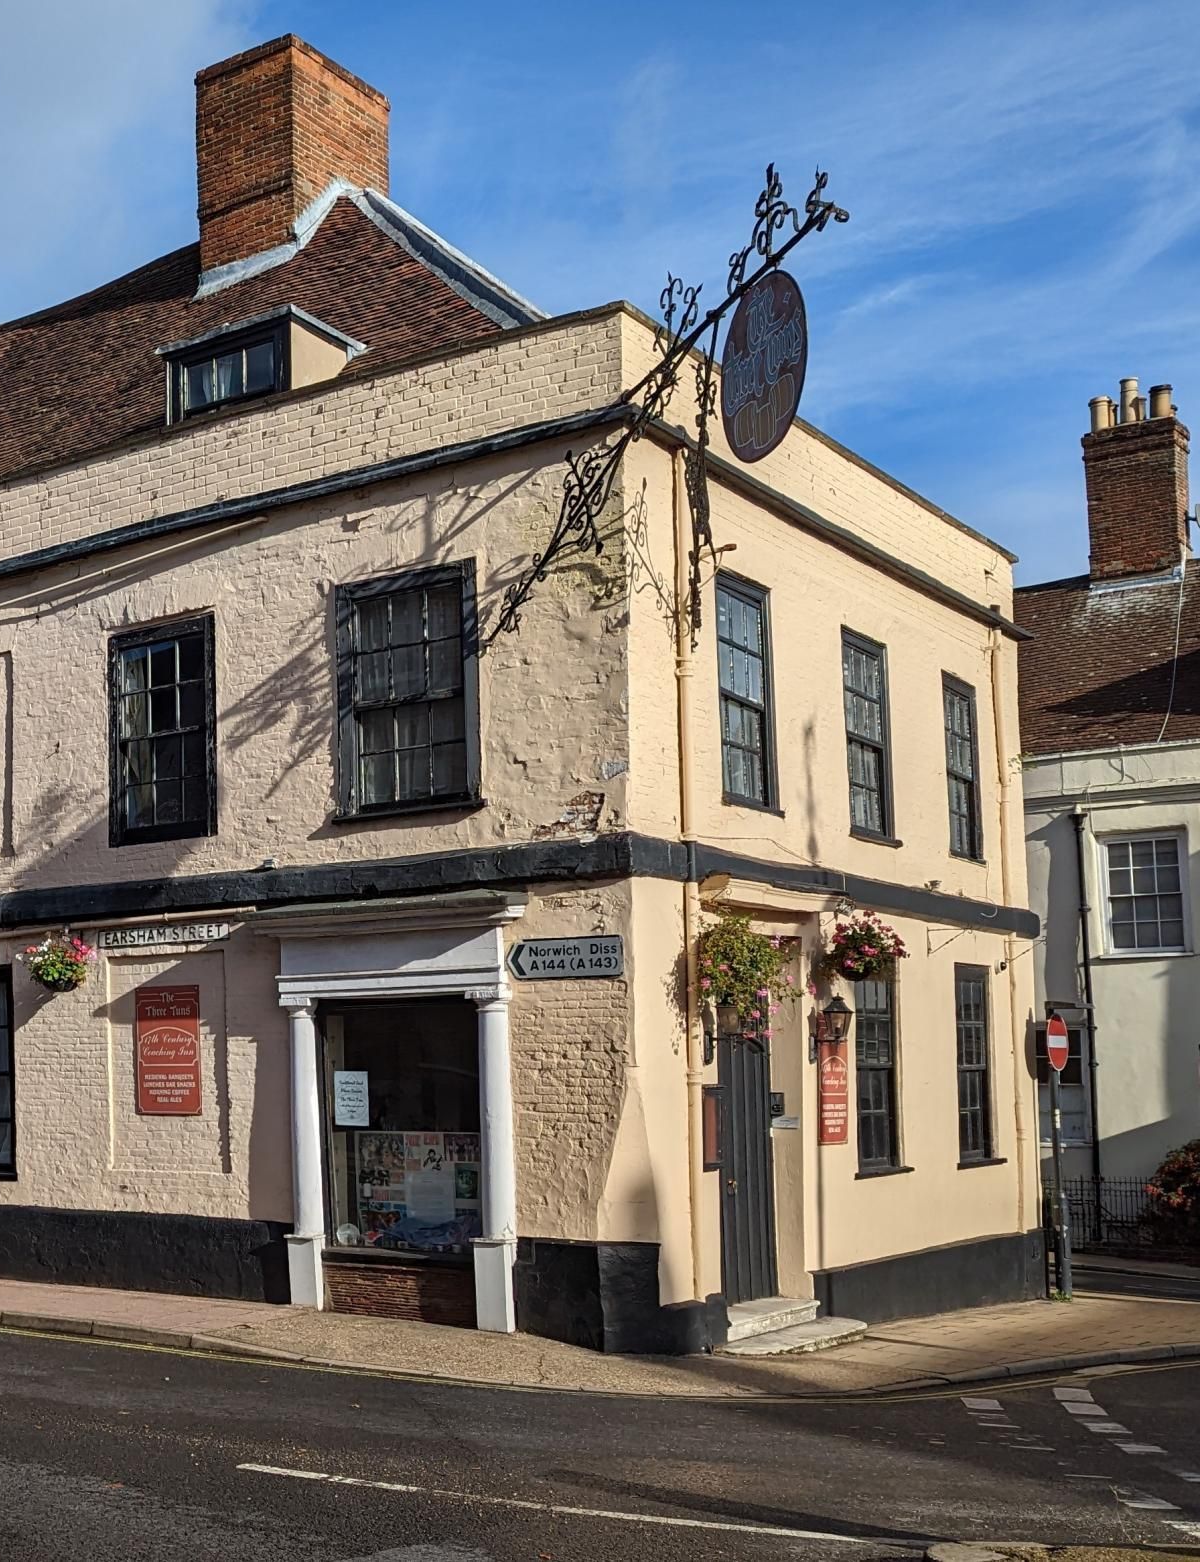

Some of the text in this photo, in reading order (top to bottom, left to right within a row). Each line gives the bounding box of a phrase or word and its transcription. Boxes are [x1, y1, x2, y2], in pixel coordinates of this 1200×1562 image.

[104, 924, 223, 946] EARSHAM STREET
[528, 943, 617, 957] Norwich Diss
[160, 992, 175, 1003] The
[145, 1005, 191, 1017] Three Tuns
[162, 1033, 193, 1047] Century
[143, 1046, 194, 1060] Coaching Inn
